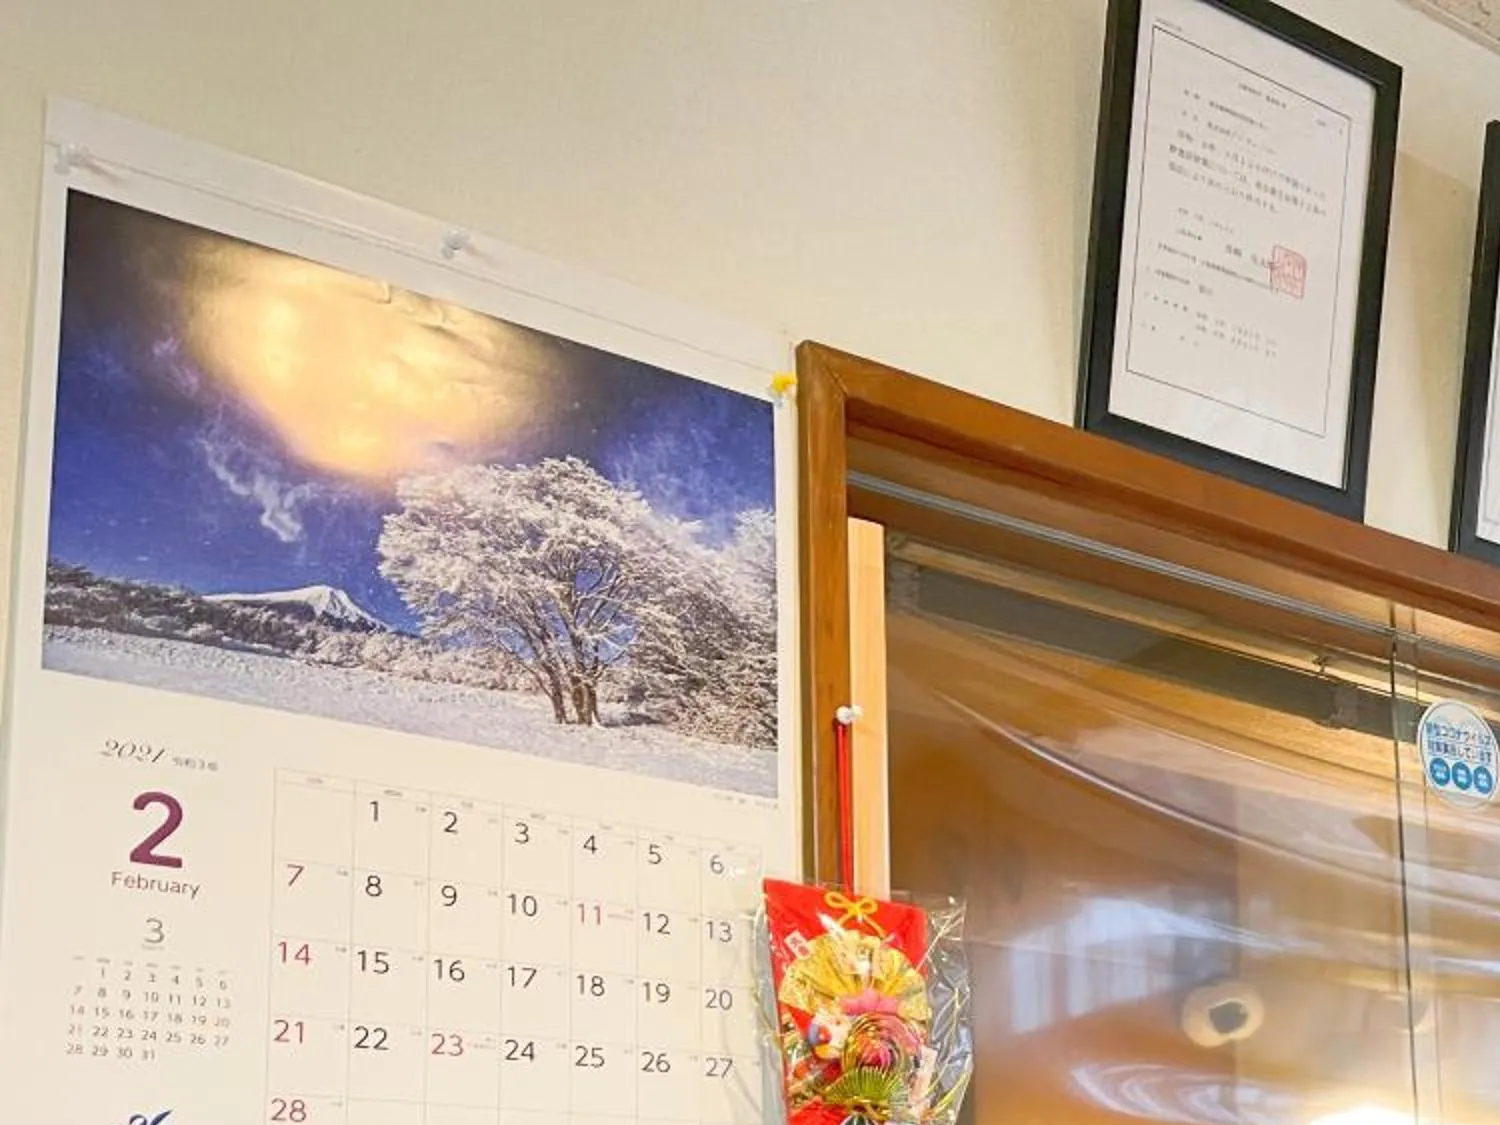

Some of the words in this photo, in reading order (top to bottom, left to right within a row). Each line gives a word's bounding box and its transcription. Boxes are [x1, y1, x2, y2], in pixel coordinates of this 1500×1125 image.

[100, 738, 166, 764] 2021
[129, 791, 183, 869] 2
[369, 800, 379, 822] 1
[443, 811, 458, 834] 2
[514, 822, 530, 845] 3
[583, 834, 598, 854] 4
[648, 843, 663, 865] 5
[709, 854, 725, 875] 6
[110, 871, 201, 899] February
[287, 863, 305, 887] 7
[365, 875, 383, 897] 8
[441, 885, 458, 907] 9
[507, 893, 538, 917] 10
[578, 903, 601, 926] 11
[643, 912, 671, 935] 12
[706, 920, 733, 943] 13
[143, 917, 166, 946] 3
[278, 941, 311, 966] 14
[357, 949, 390, 975] 15
[434, 958, 465, 983] 16
[507, 965, 538, 989] 17
[576, 974, 605, 997] 18
[643, 981, 671, 1004] 19
[705, 988, 733, 1011] 20
[273, 1019, 304, 1044] 21
[354, 1025, 388, 1051] 22
[431, 1033, 464, 1057] 23
[504, 1039, 535, 1061] 24
[575, 1045, 605, 1069] 25
[641, 1051, 671, 1073] 26
[705, 1057, 734, 1079] 27
[270, 1097, 307, 1123] 28
